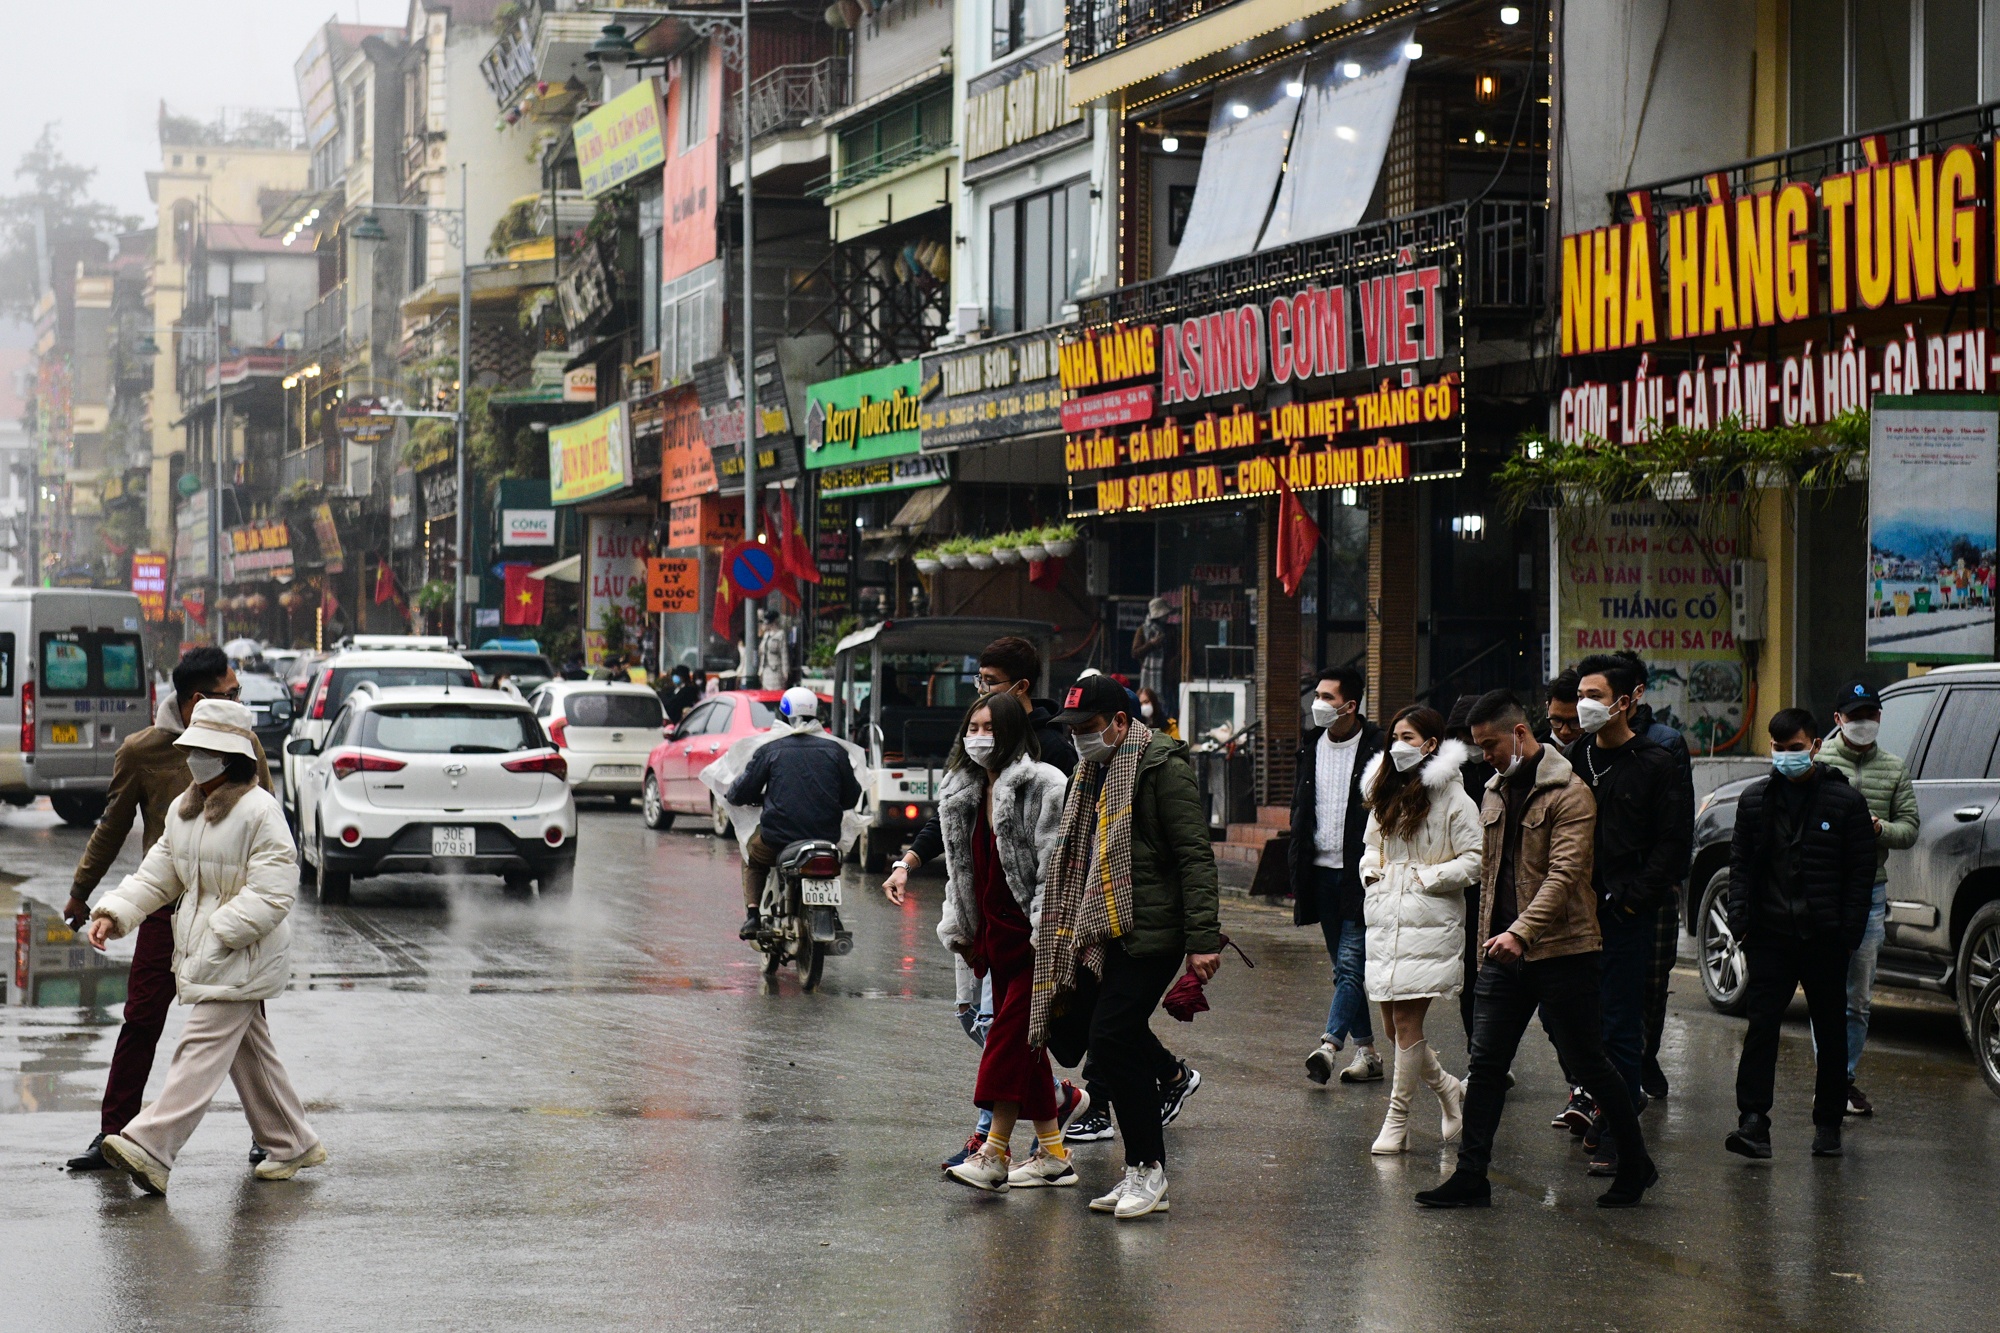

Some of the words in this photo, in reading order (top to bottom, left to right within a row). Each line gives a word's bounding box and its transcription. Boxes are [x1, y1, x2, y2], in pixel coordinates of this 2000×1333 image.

[1561, 190, 1657, 357] NHÀ
[1668, 172, 1812, 340] HÀNG
[1821, 134, 1982, 314] TÙNG
[1058, 328, 1099, 389] NHÀ
[1101, 322, 1156, 383] HÀNG
[1162, 304, 1262, 405] ASIMO
[1269, 284, 1350, 384] CƠM
[1360, 246, 1443, 388] VIỆT
[1560, 380, 1608, 448] CƠM
[1677, 353, 1710, 433] CÁ
[1782, 339, 1817, 427] CÁ
[1884, 322, 1920, 395] GÀ
[826, 402, 858, 450] Berry
[860, 395, 891, 438] House
[1129, 424, 1150, 463] CÁ
[1308, 398, 1345, 441] MẸT
[1097, 478, 1124, 512] RAU
[1172, 469, 1192, 504] SA
[1196, 465, 1218, 499] PA
[1238, 455, 1276, 493] CƠM
[1315, 444, 1358, 485] BÌNH
[663, 572, 681, 584] LÝ
[1599, 590, 1678, 619] THẮNG
[1684, 591, 1718, 619] CỐ
[1576, 629, 1616, 649] RAU
[1622, 629, 1675, 653] SẠCH
[1681, 629, 1705, 649] SA
[1711, 629, 1735, 649] PA
[443, 827, 464, 840] 30E
